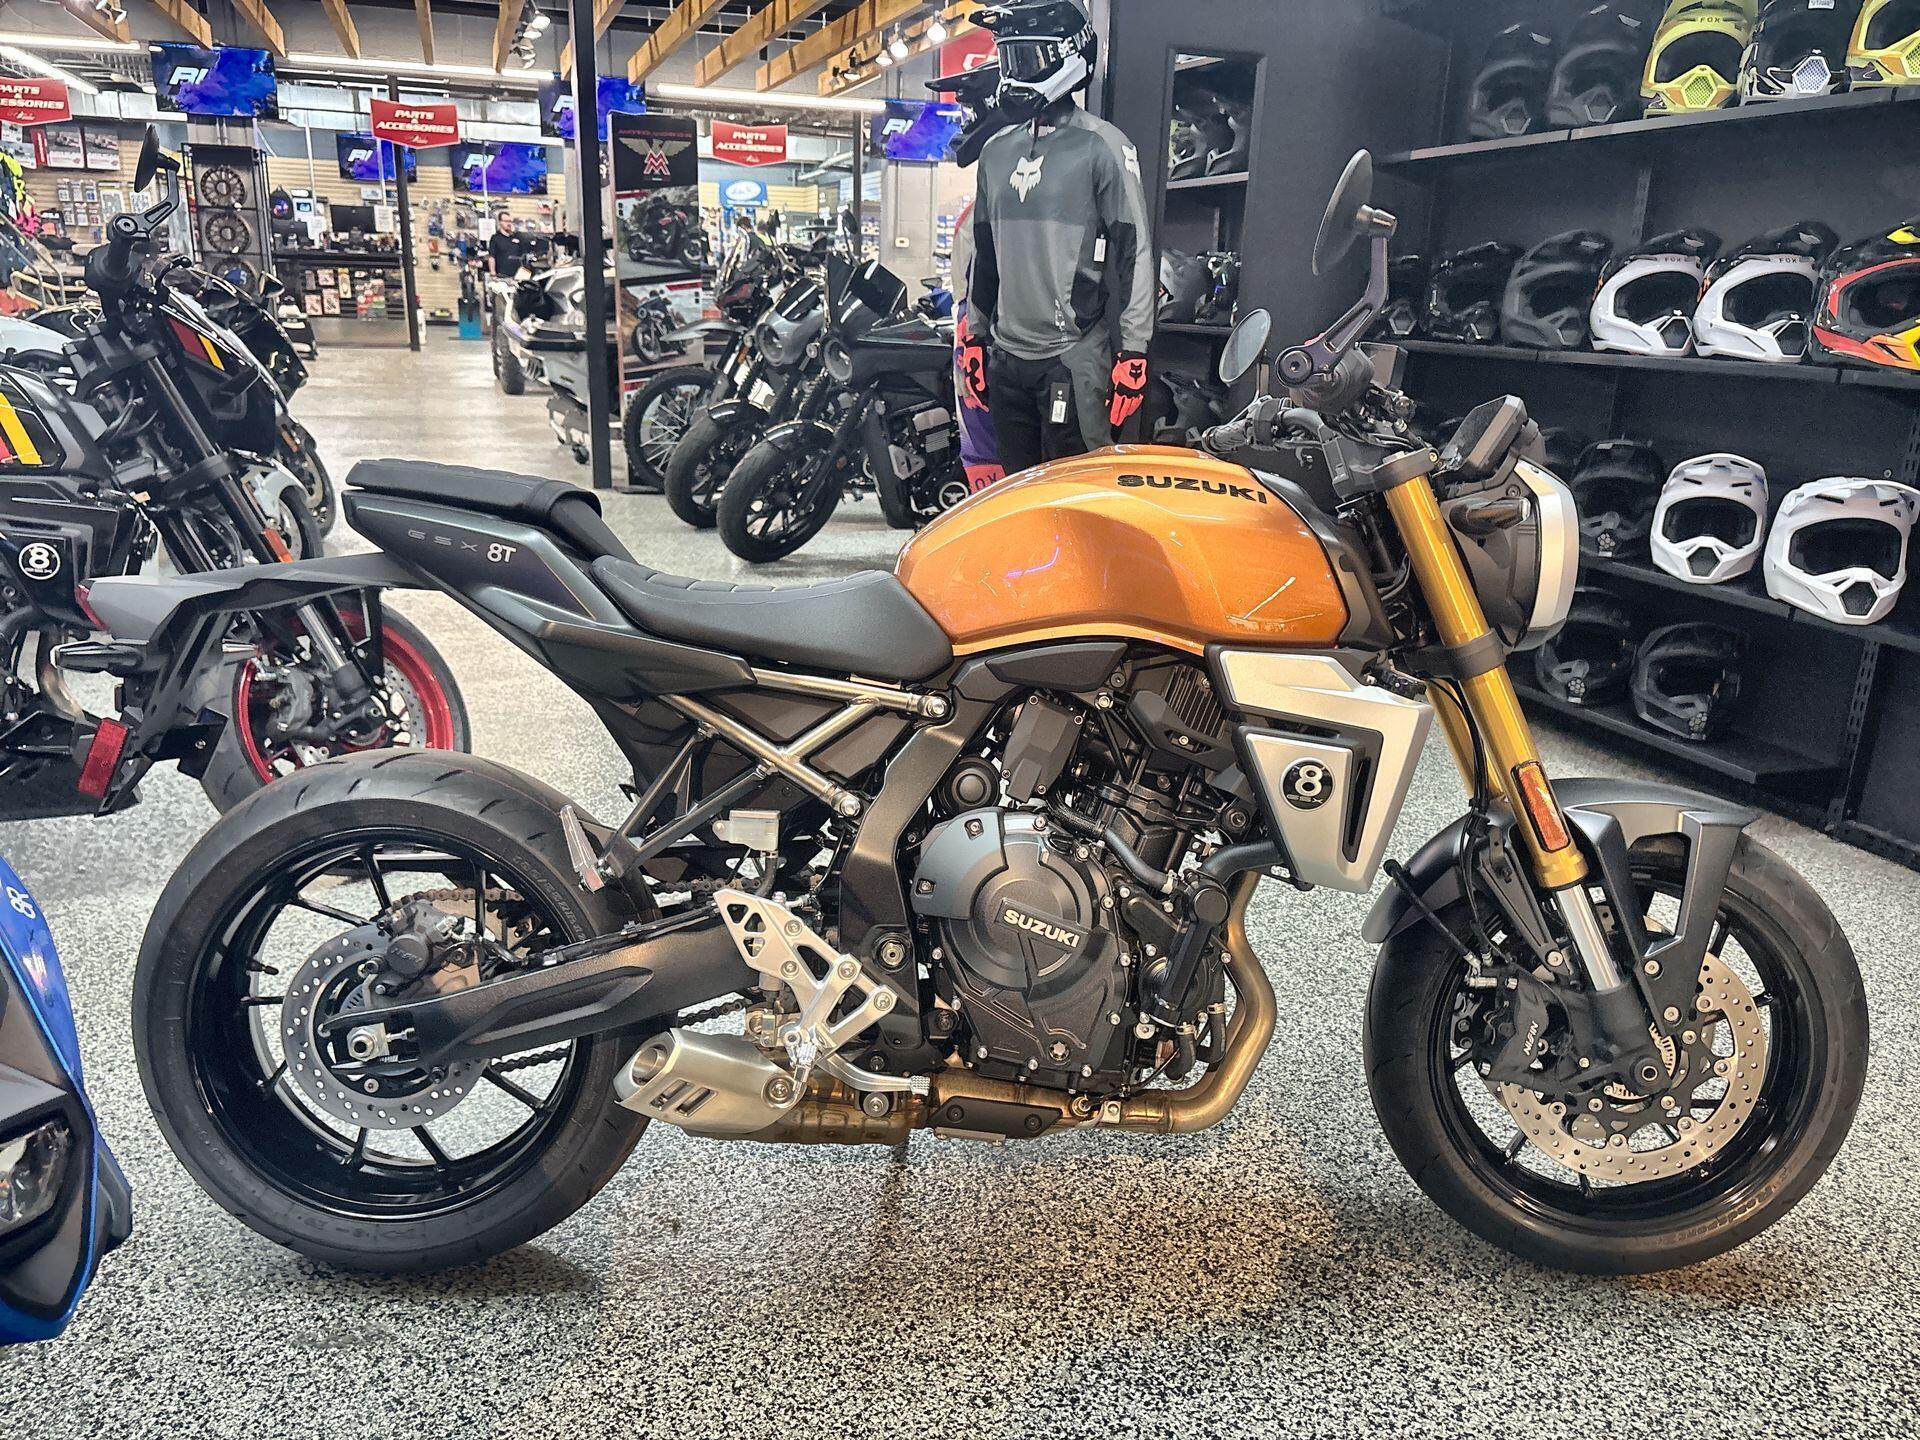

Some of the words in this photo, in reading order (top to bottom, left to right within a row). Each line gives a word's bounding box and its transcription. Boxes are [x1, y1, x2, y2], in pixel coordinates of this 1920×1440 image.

[1699, 16, 1721, 24] FOX
[394, 109, 435, 120] PARTS
[376, 121, 455, 134] ACCESSORIES
[732, 131, 768, 141] PARTS
[715, 141, 784, 154] ACCESSORIES
[1779, 256, 1797, 264] FOX
[1117, 474, 1268, 505] SUZUKI
[28, 546, 51, 570] 8
[487, 542, 517, 563] 8T
[1294, 764, 1323, 797] 8
[6, 886, 36, 919] 8R
[1003, 909, 1080, 948] SUZUKI
